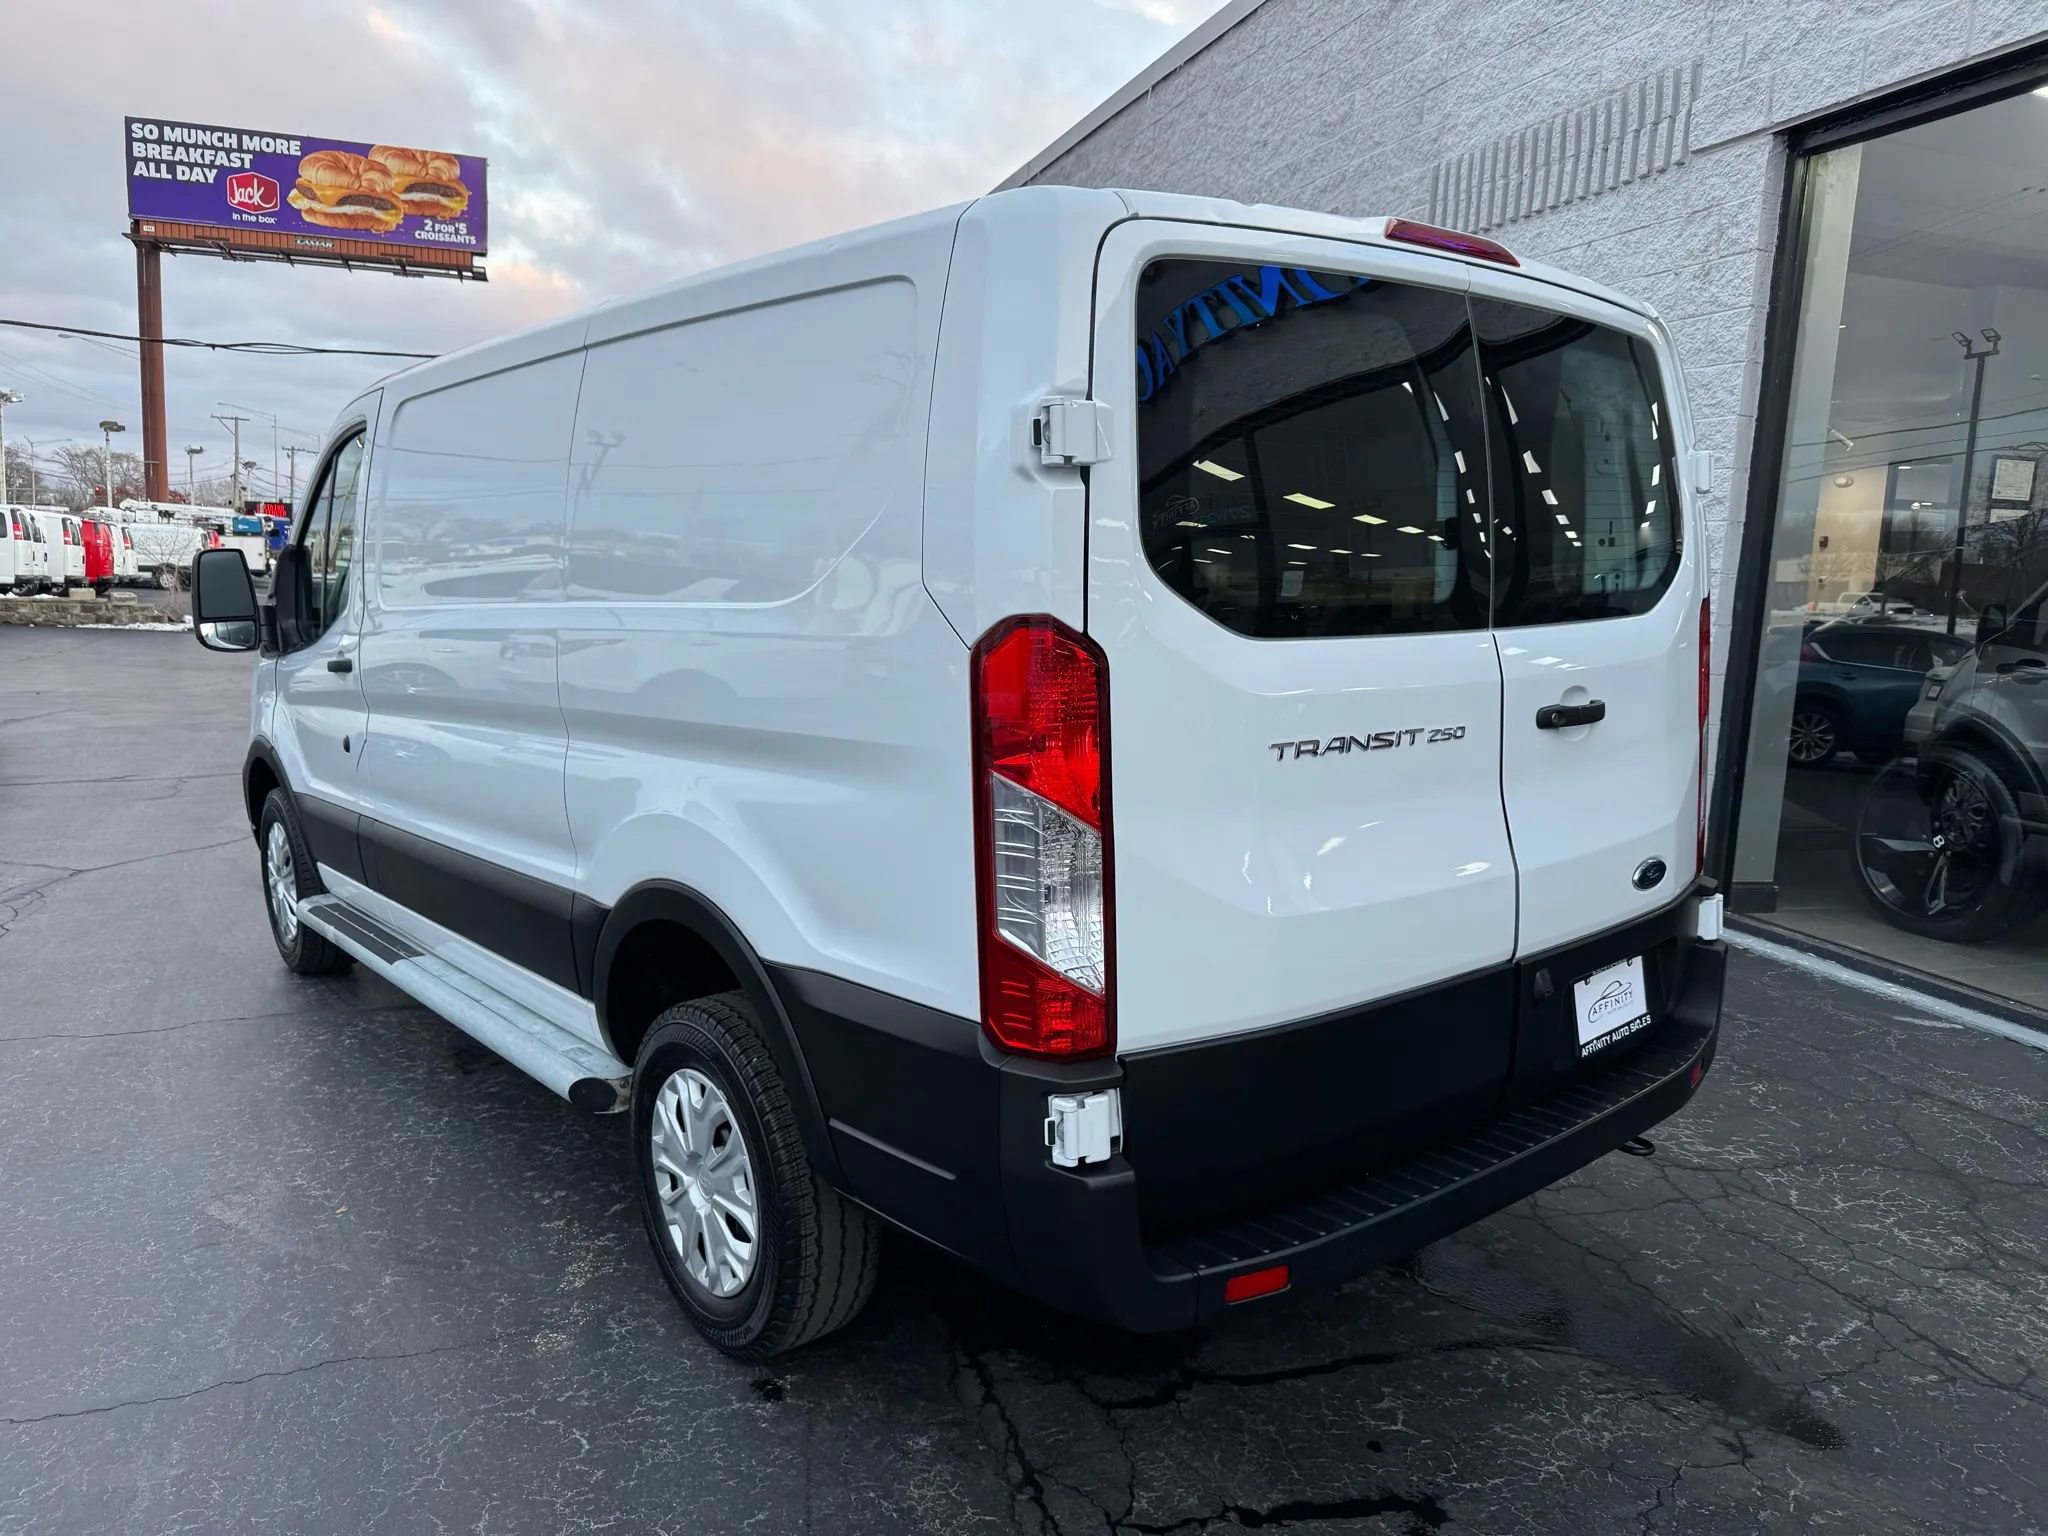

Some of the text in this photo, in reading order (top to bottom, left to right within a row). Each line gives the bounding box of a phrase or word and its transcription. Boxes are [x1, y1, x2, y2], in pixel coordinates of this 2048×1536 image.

[131, 122, 302, 156] SO MUNCH MORE
[132, 141, 254, 169] BREAKFAST
[133, 160, 218, 184] ALL DAY
[230, 177, 277, 208] Jack
[242, 213, 257, 222] the
[423, 219, 433, 232] 2
[434, 222, 455, 234] FOR
[296, 239, 333, 248] LAMAR
[414, 230, 477, 245] CROISSANTS
[1268, 726, 1466, 761] TRANSIT 250
[1591, 990, 1633, 1016] AFFINITY
[1581, 1014, 1652, 1058] AFFINITY AUTO SALES
